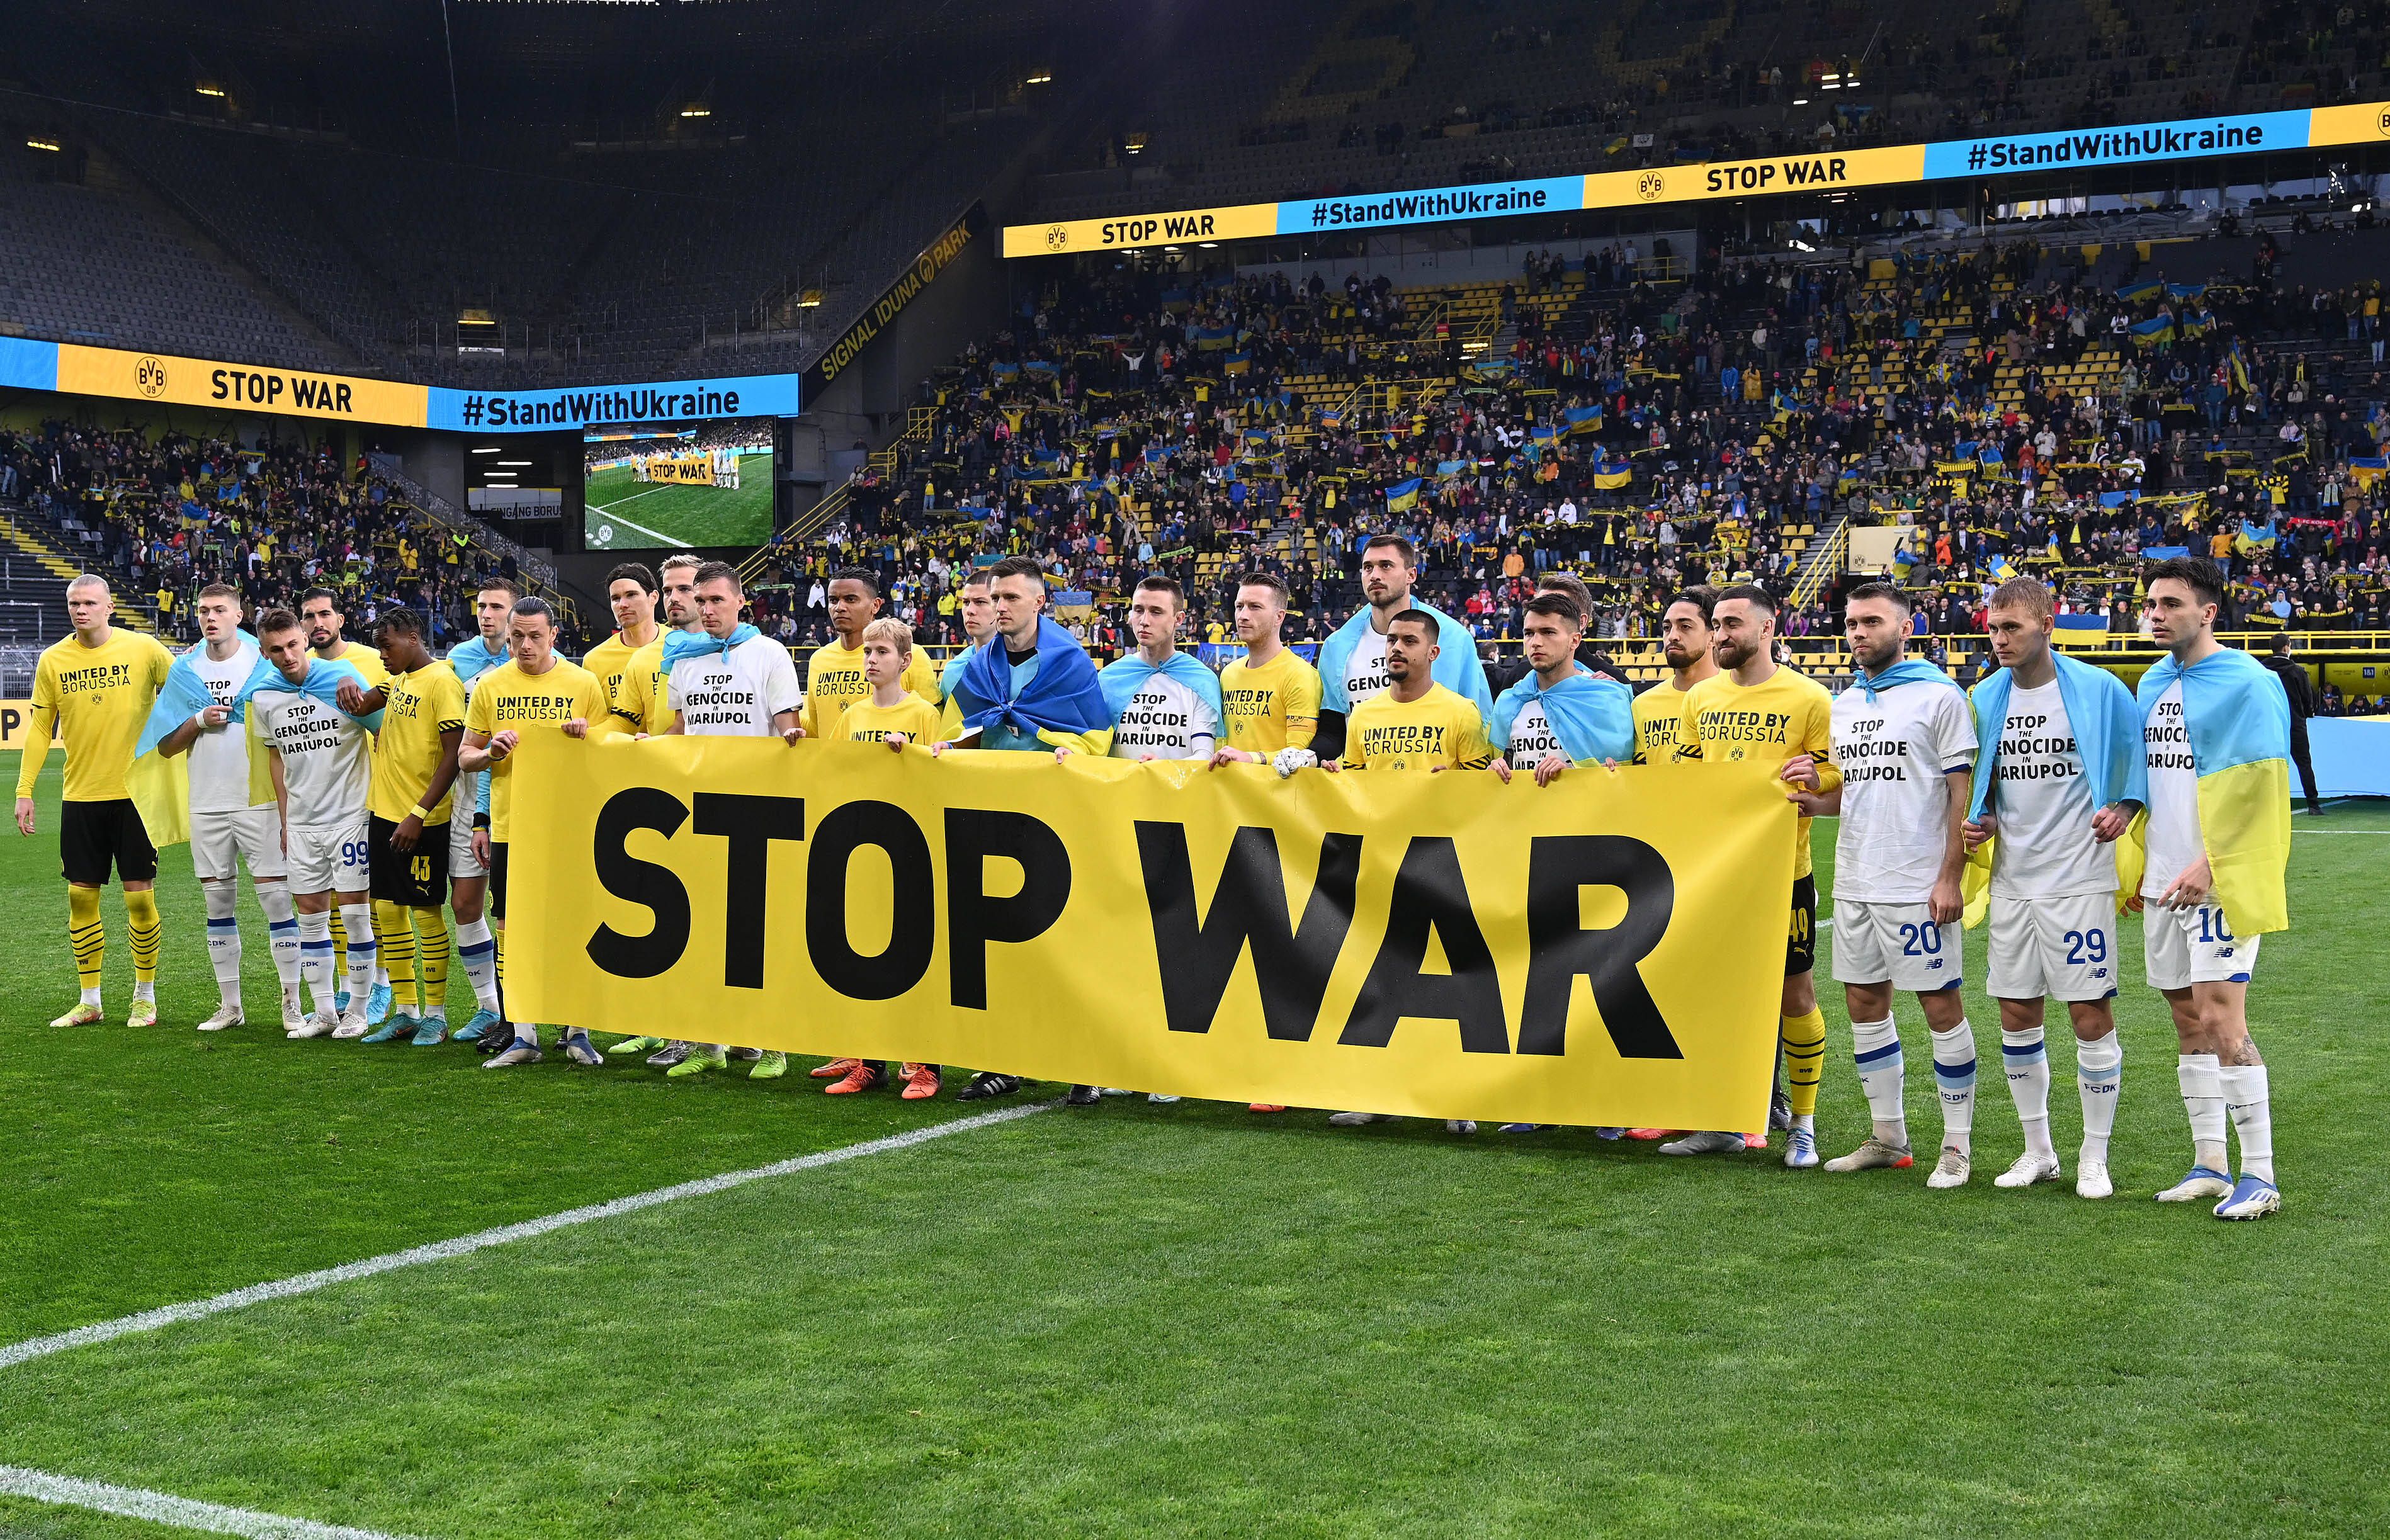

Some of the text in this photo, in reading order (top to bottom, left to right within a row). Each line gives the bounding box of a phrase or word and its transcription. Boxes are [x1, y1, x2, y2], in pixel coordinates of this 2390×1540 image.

[1968, 121, 2263, 171] #StandWithUkraine
[1641, 174, 1662, 193] BVB
[1707, 158, 1847, 192] STOP WAR
[1311, 188, 1547, 227] #StandWithUkraine
[1048, 227, 1065, 244] BVB
[1102, 215, 1215, 244] STOP WAR
[822, 219, 972, 381] SIGNAL IDUNA PARK
[139, 360, 164, 387] BVB
[211, 369, 353, 413] STOP WAR
[463, 385, 740, 427] #StandWithUkraine
[654, 463, 706, 480] STOP WAR
[60, 664, 129, 683] UNITED BY
[703, 674, 732, 685] STOP
[818, 671, 860, 684] UNITED
[62, 676, 131, 694] BORUSSIA
[816, 682, 873, 696] BORUSSI
[405, 694, 421, 707] BY
[497, 696, 574, 708] UNITED BY
[686, 692, 753, 706] GENOCIDE
[1132, 694, 1167, 705] STOP
[1255, 690, 1273, 704] BY
[287, 705, 316, 718] STOP
[497, 708, 572, 721] BORUSSIA
[1223, 703, 1271, 716] ORUSSIA
[2158, 703, 2183, 716] STO
[688, 712, 751, 726] MARIUPOL
[1119, 711, 1187, 727] ENOCIDE
[1645, 717, 1681, 734] UNIT
[1699, 712, 1791, 729] UNITED BY
[1851, 719, 1884, 733] STOP
[2007, 715, 2046, 730] STOP
[275, 718, 339, 739] GENOCIDE
[1364, 726, 1445, 742] UNITED BY
[1700, 726, 1786, 744] BORUSSIA
[1113, 732, 1186, 748] MARIUPOL
[1364, 740, 1442, 756] BORUSSIA
[1996, 738, 2076, 756] ENOCIDE
[2147, 753, 2195, 770] ARIUPO
[1843, 766, 1906, 783] ARIUPOL
[342, 841, 369, 867] 99
[411, 856, 430, 881] 43
[586, 786, 1685, 1060] STOP WAR
[1789, 907, 1808, 943] 49
[2199, 907, 2234, 943] 10
[1900, 920, 1942, 956] 20
[2064, 929, 2107, 965] 29
